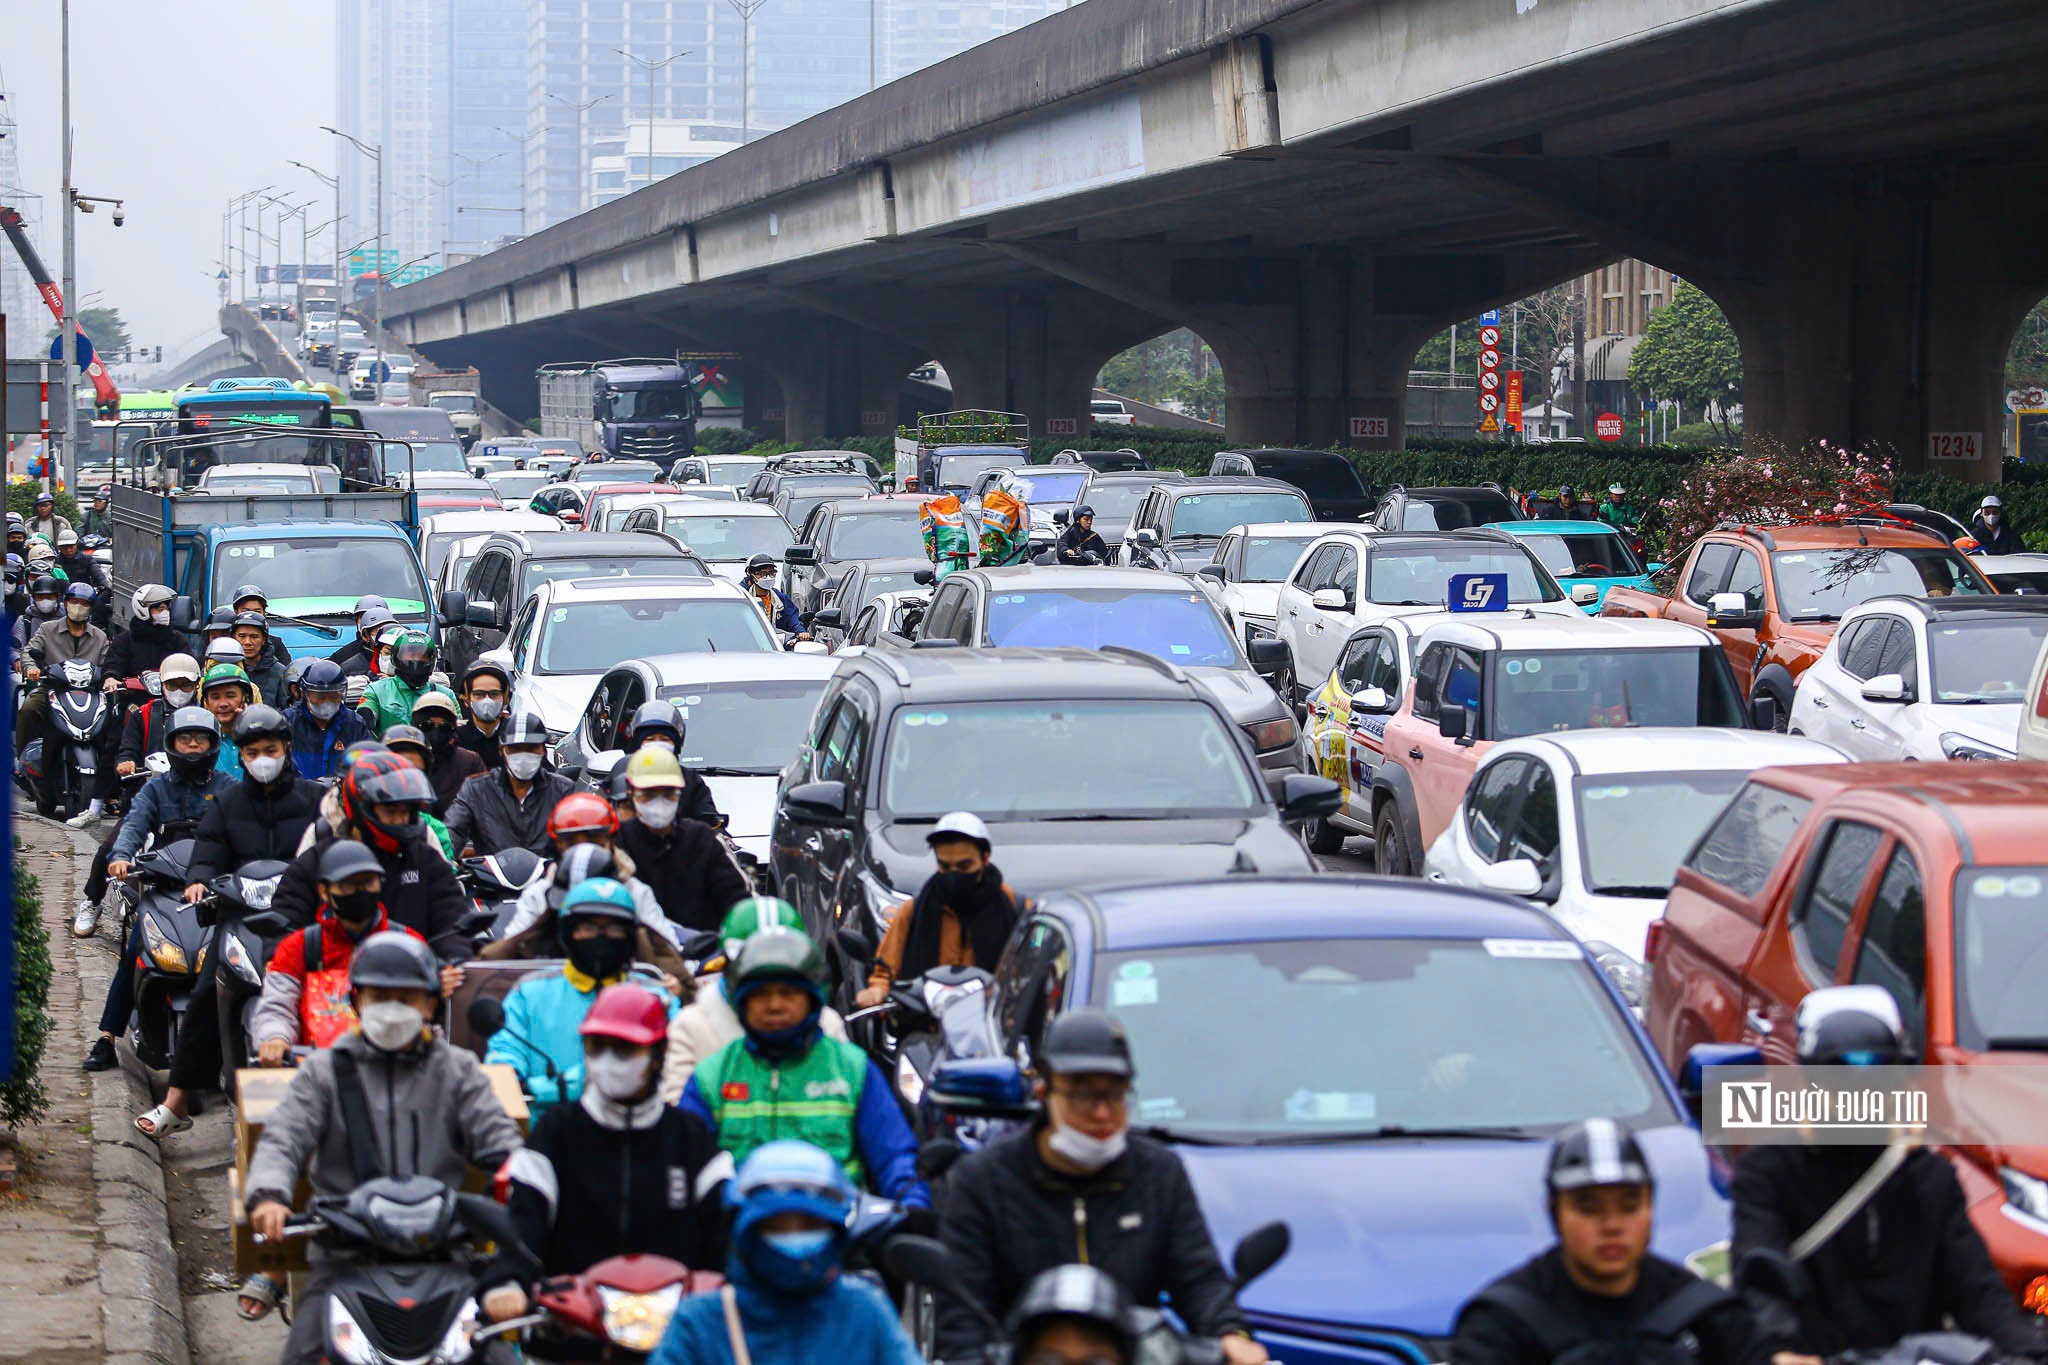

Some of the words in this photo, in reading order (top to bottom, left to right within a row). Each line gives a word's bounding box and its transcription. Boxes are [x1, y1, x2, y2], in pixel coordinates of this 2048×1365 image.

[46, 286, 61, 307] UNIC
[1352, 420, 1385, 435] T235
[1597, 420, 1621, 428] RUSTIC
[1598, 428, 1622, 436] HOME
[1931, 435, 1977, 457] T234
[1465, 578, 1495, 608] G7
